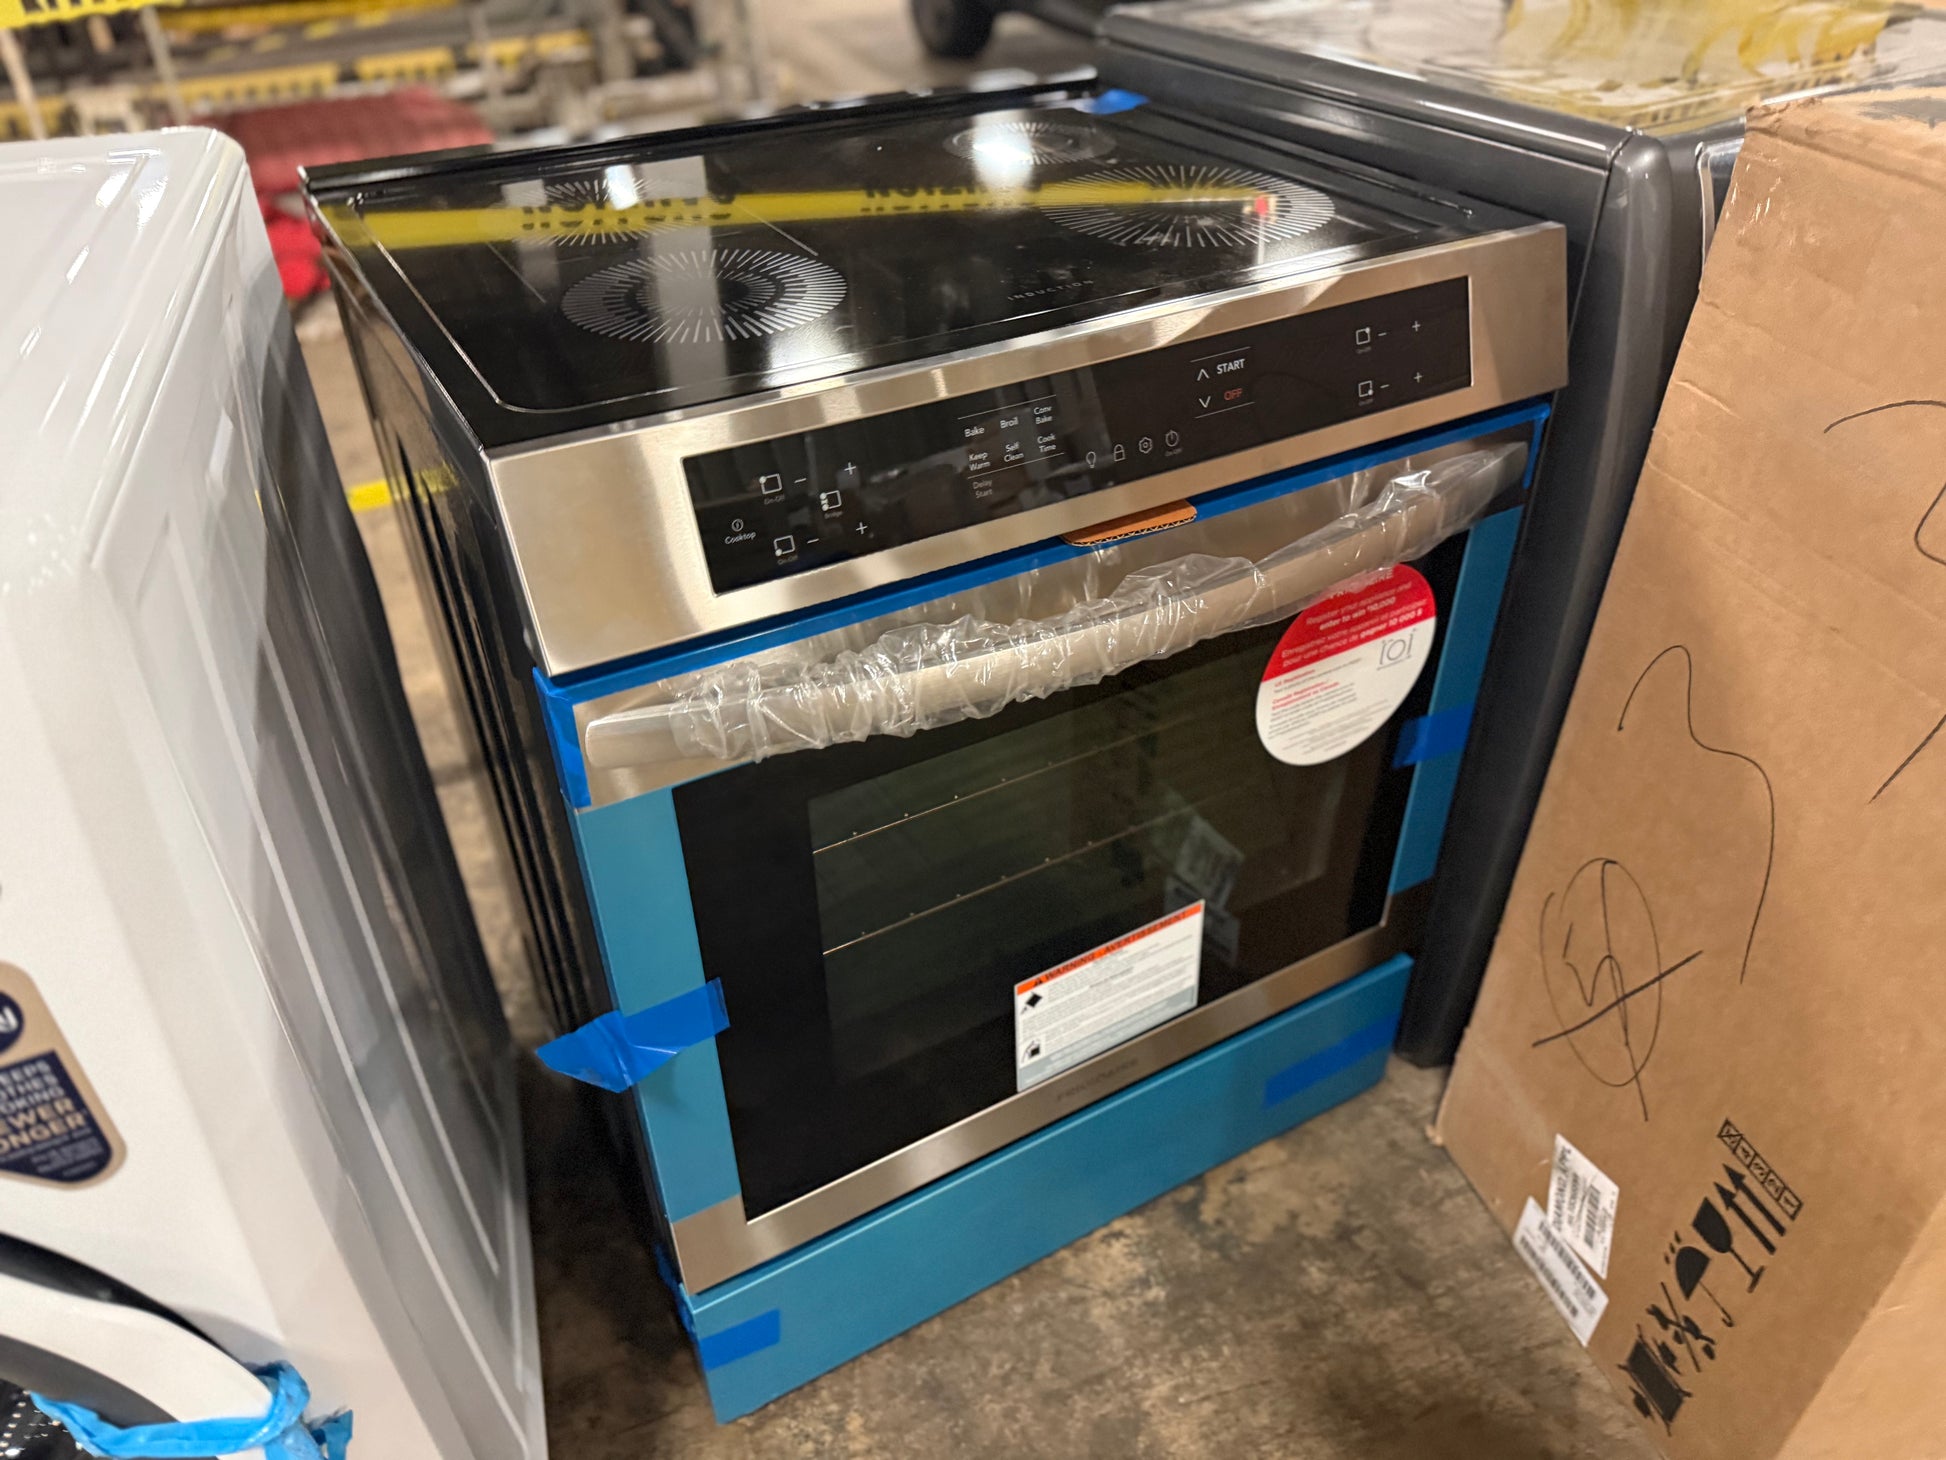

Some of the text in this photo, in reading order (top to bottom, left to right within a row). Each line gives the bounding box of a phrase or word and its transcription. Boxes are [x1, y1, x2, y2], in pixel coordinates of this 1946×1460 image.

[1216, 358, 1246, 375] START
[1224, 388, 1243, 401] OFF
[964, 416, 1019, 438] Bake Broil
[1037, 432, 1056, 444] Cook
[724, 530, 757, 545] Cooktop
